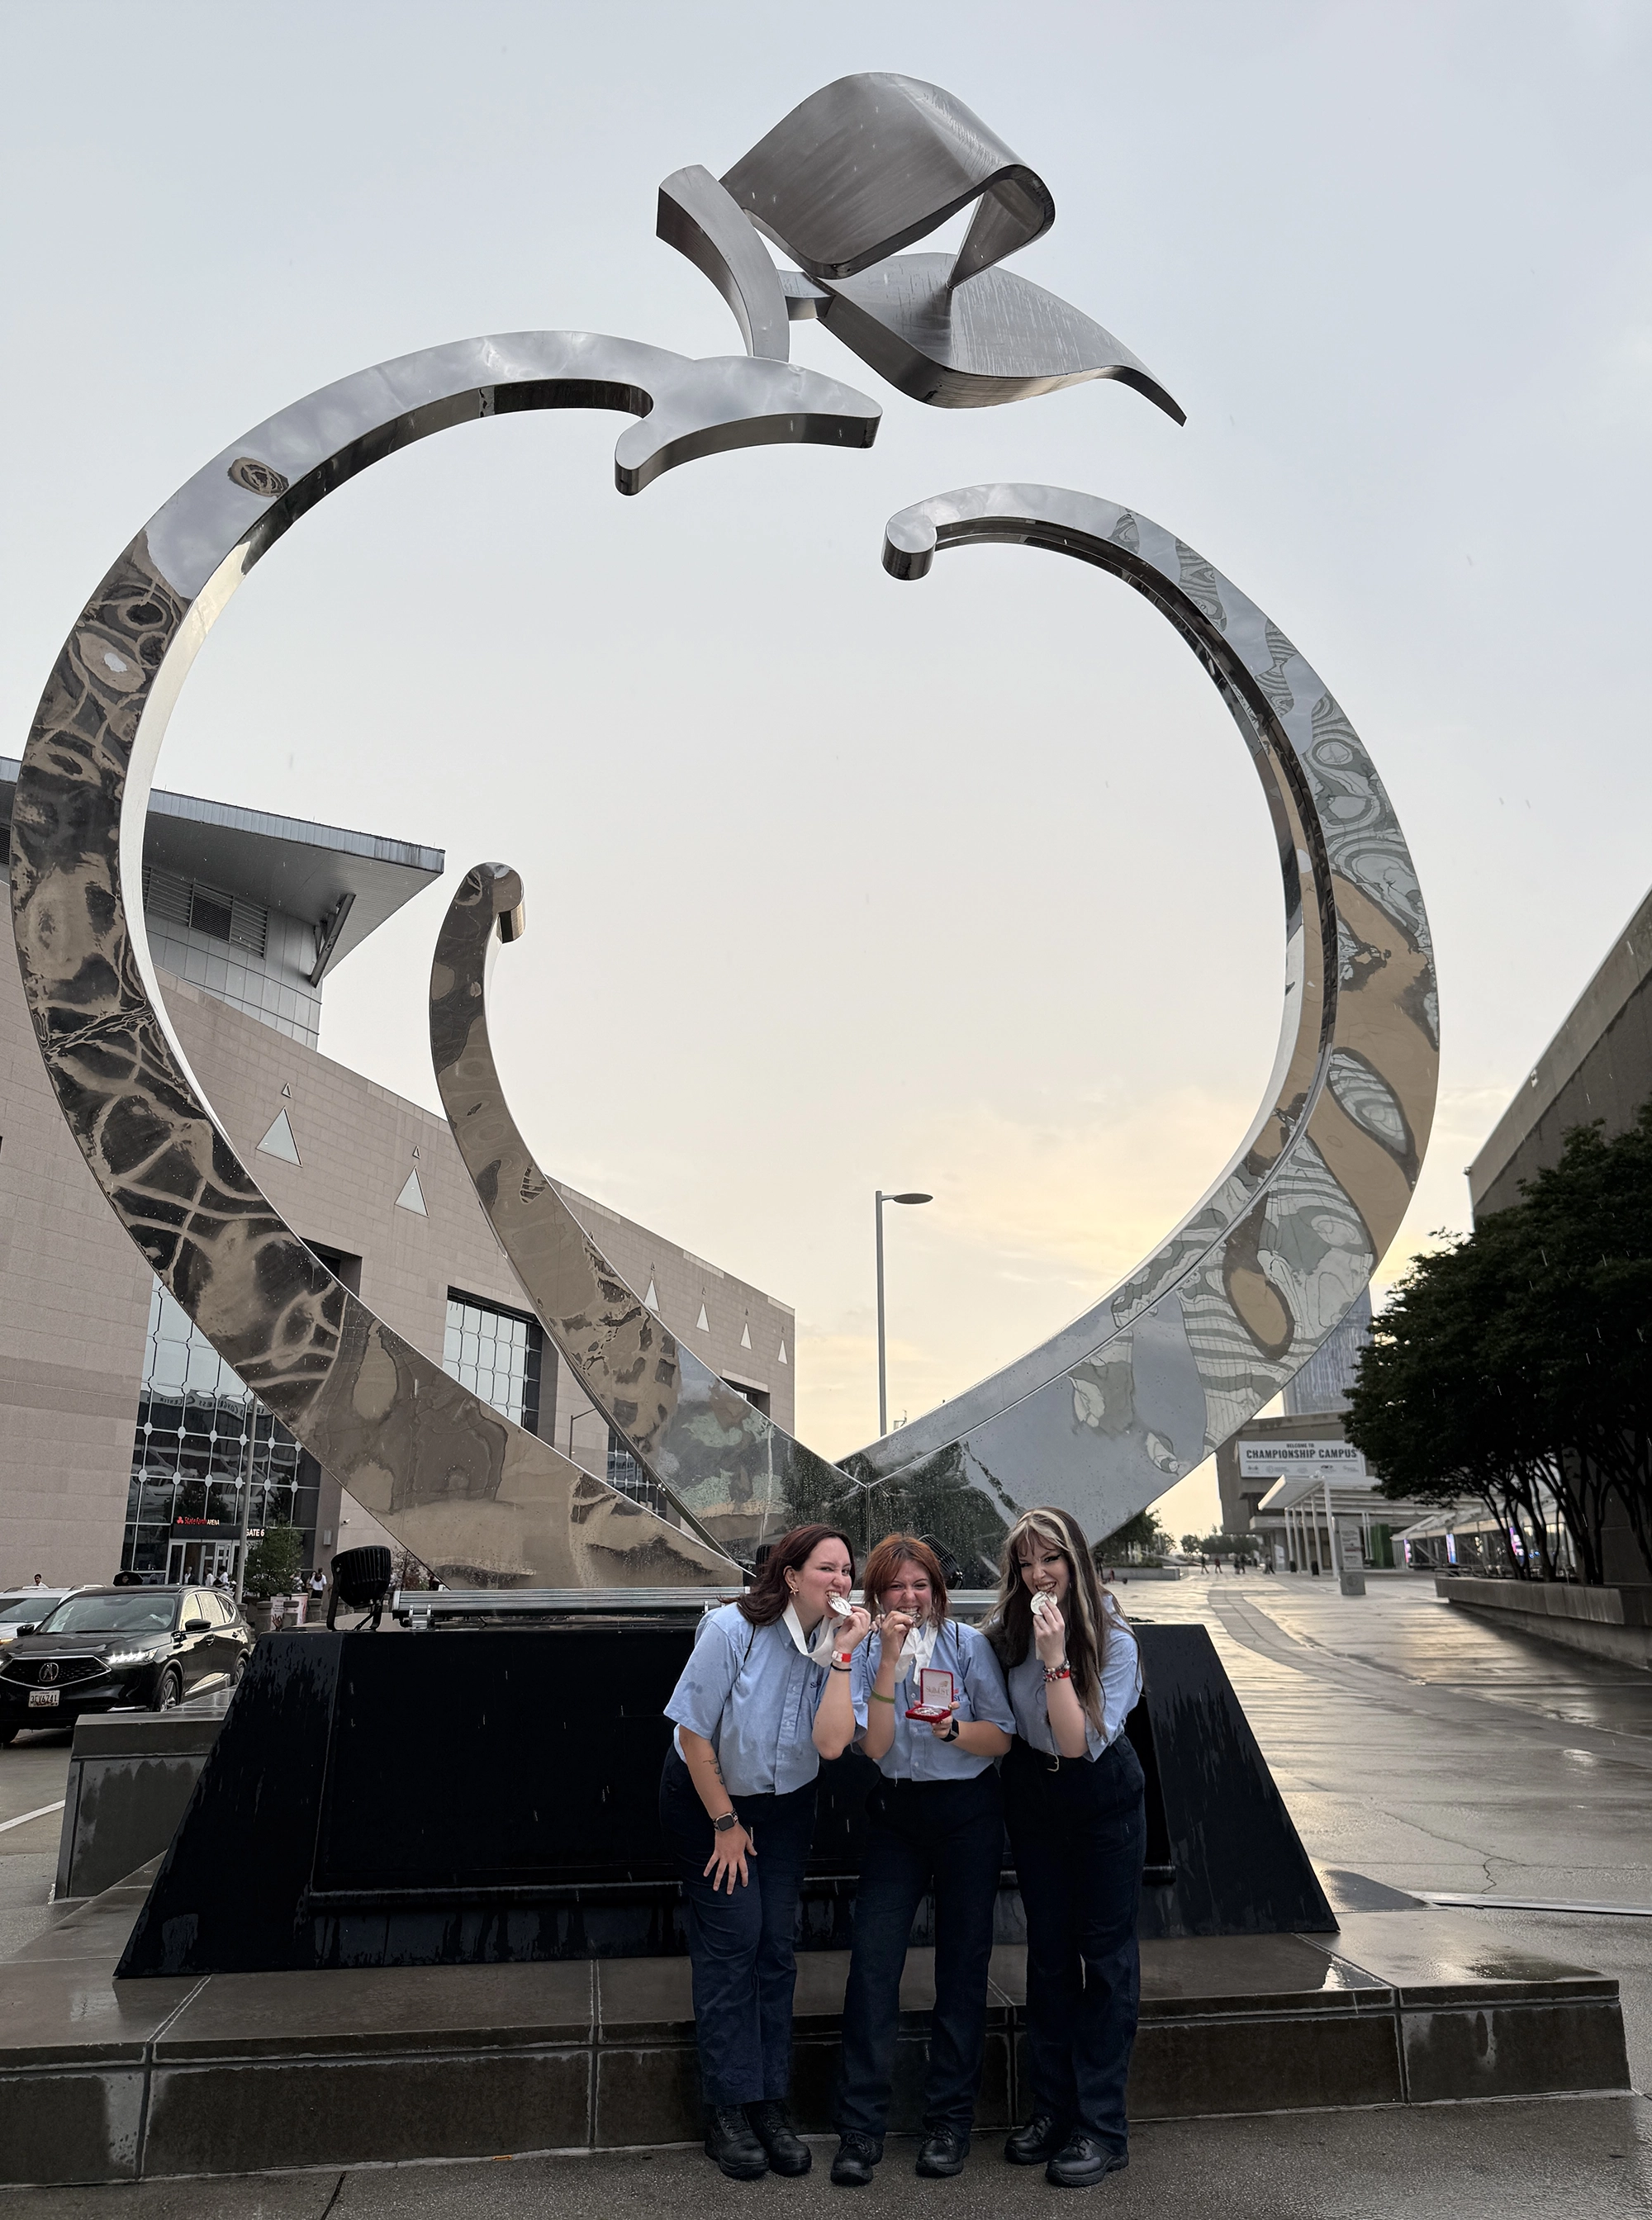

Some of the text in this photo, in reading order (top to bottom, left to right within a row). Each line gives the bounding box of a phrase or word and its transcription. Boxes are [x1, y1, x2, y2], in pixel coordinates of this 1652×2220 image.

[1246, 1449, 1357, 1459] CHAMPIONSHIP CAMPUS
[260, 1528, 265, 1537] 6
